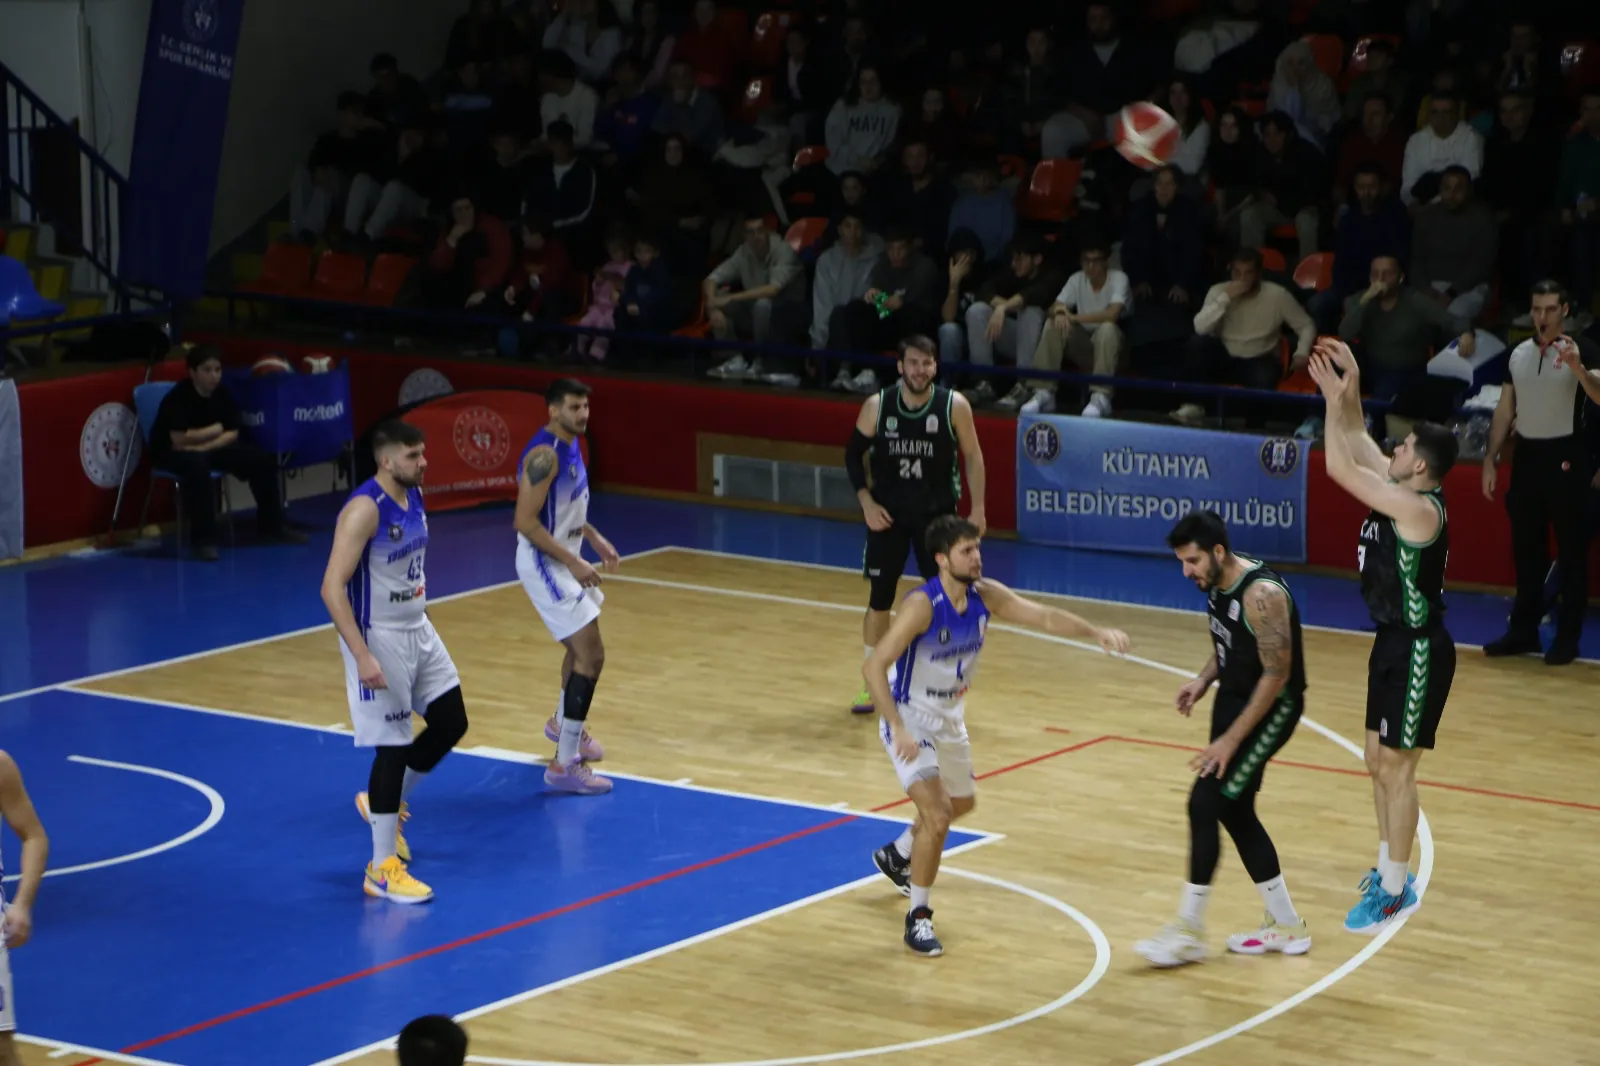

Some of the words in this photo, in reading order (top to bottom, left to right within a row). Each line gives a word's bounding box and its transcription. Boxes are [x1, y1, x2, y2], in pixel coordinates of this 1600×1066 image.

[294, 400, 344, 422] molten
[888, 439, 934, 457] SAKARYA
[899, 457, 923, 479] 24
[1102, 446, 1211, 480] KÜTAHYA
[1025, 487, 1192, 521] BELEDİYESPOR
[407, 555, 421, 581] 43
